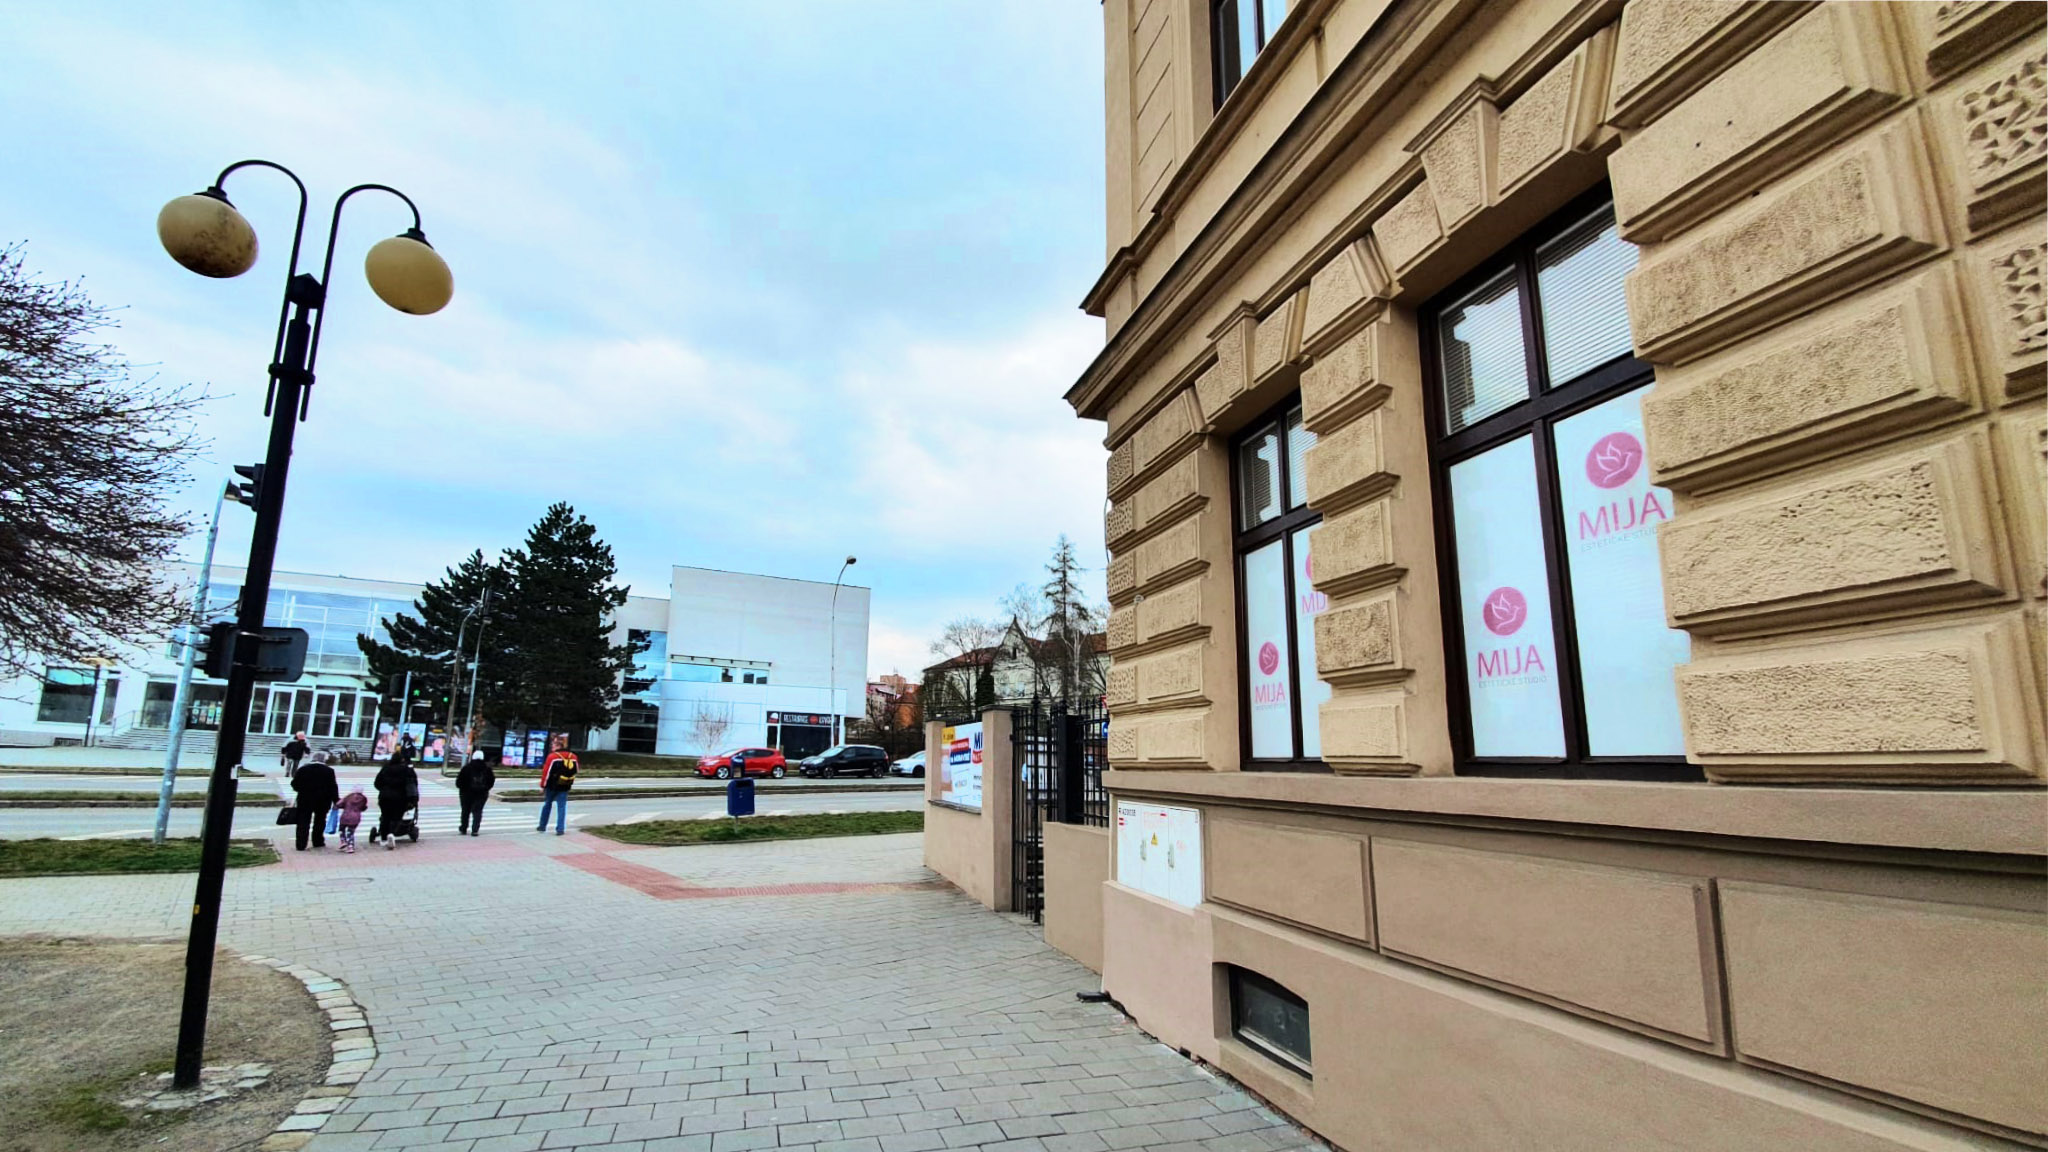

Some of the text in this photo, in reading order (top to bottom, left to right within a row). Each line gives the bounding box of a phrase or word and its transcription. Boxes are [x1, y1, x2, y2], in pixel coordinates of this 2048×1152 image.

[1579, 491, 1667, 540] MIJA
[1302, 592, 1326, 614] MIJ
[1478, 644, 1546, 678] MIJA
[1254, 682, 1286, 703] MIJA
